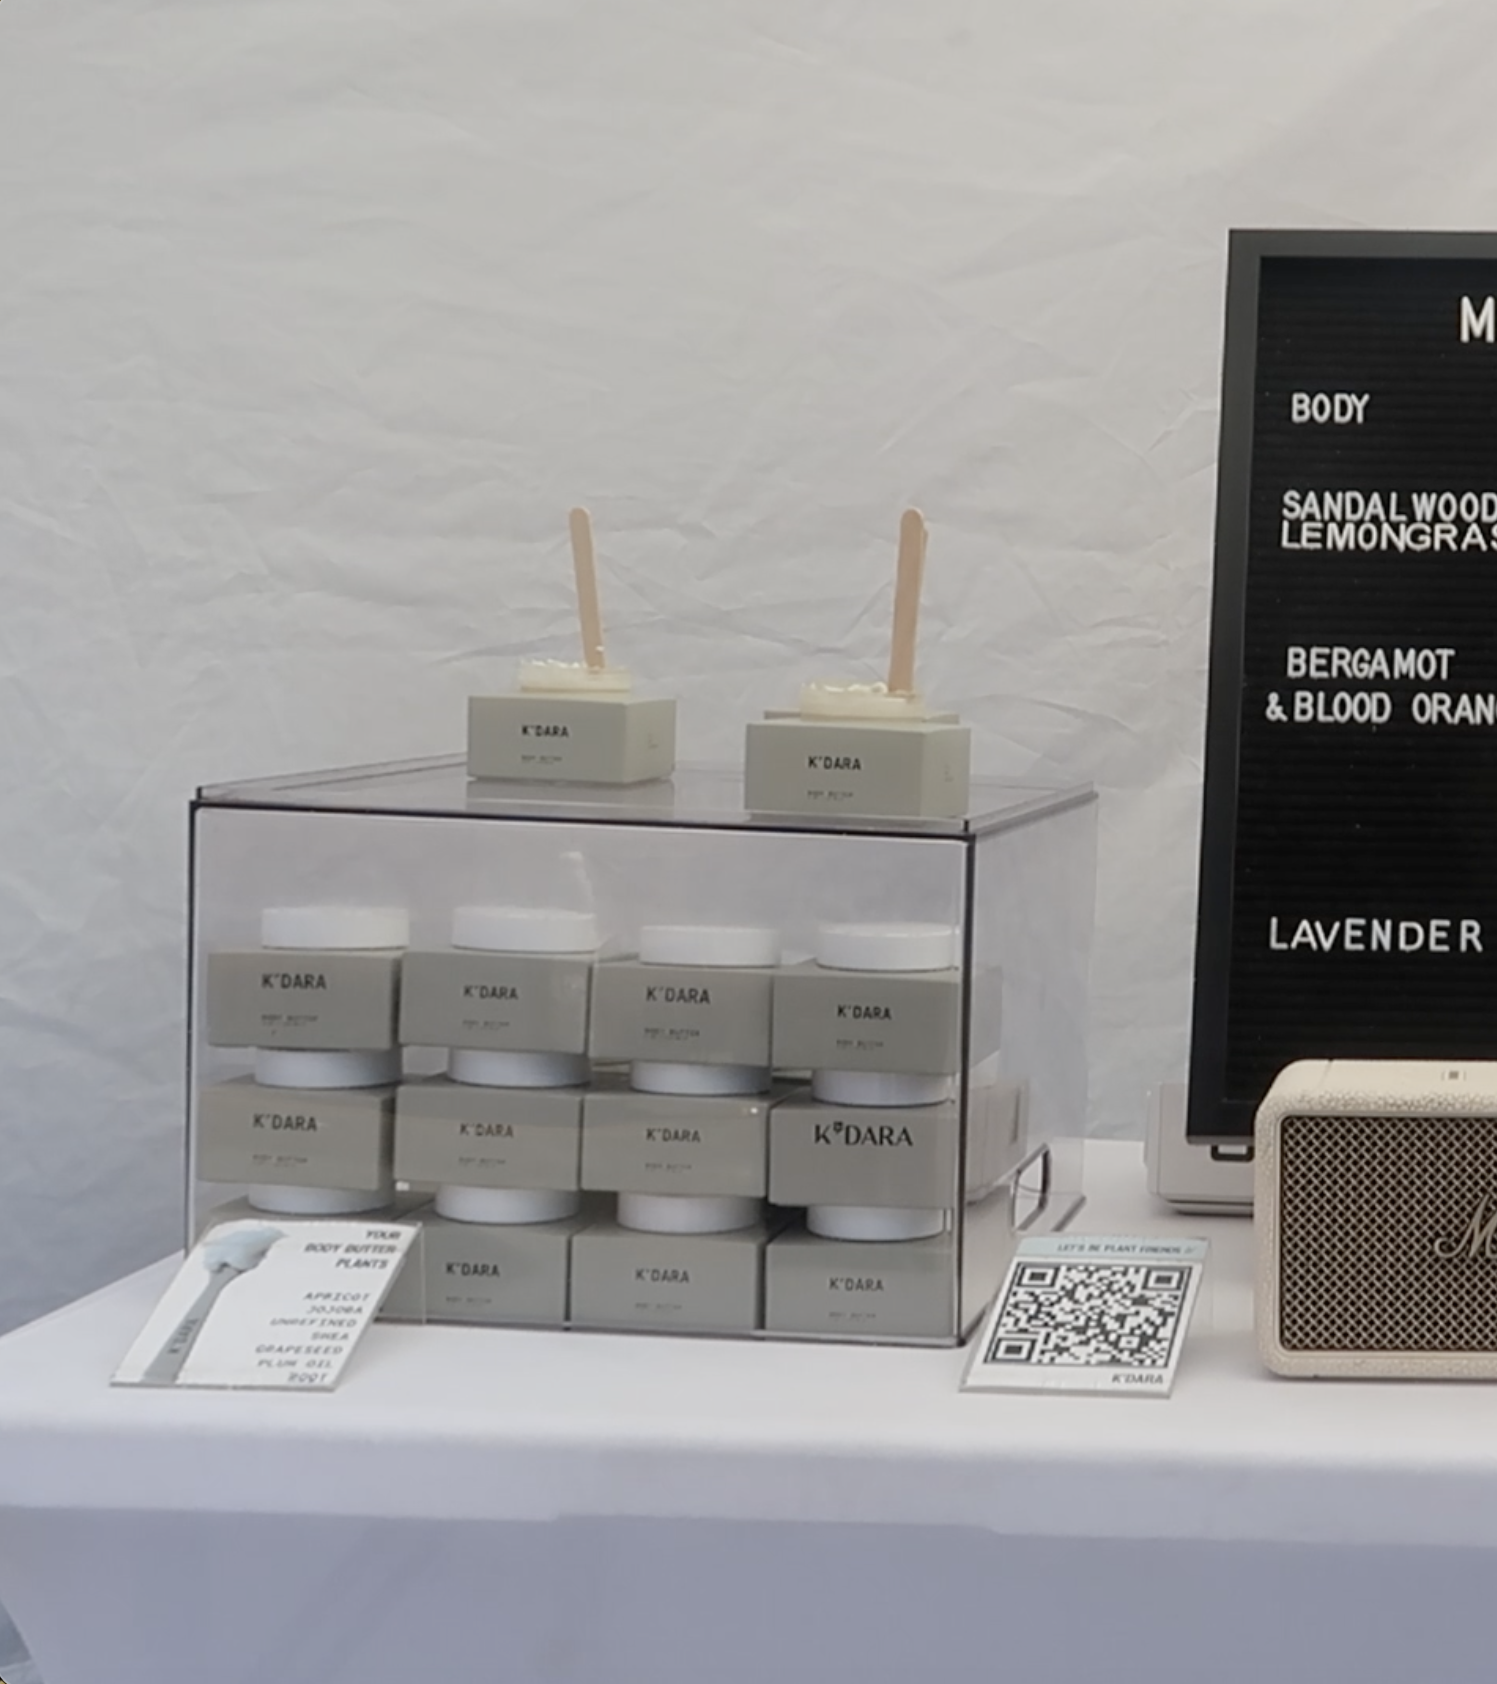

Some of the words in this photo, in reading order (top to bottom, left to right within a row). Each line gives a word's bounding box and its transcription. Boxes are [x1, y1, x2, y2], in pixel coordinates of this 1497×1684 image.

[1291, 392, 1370, 424] BODY
[1287, 646, 1456, 681] BERGAMOT
[1269, 916, 1483, 953] LAVENDER
[335, 1258, 388, 1269] PLANTS
